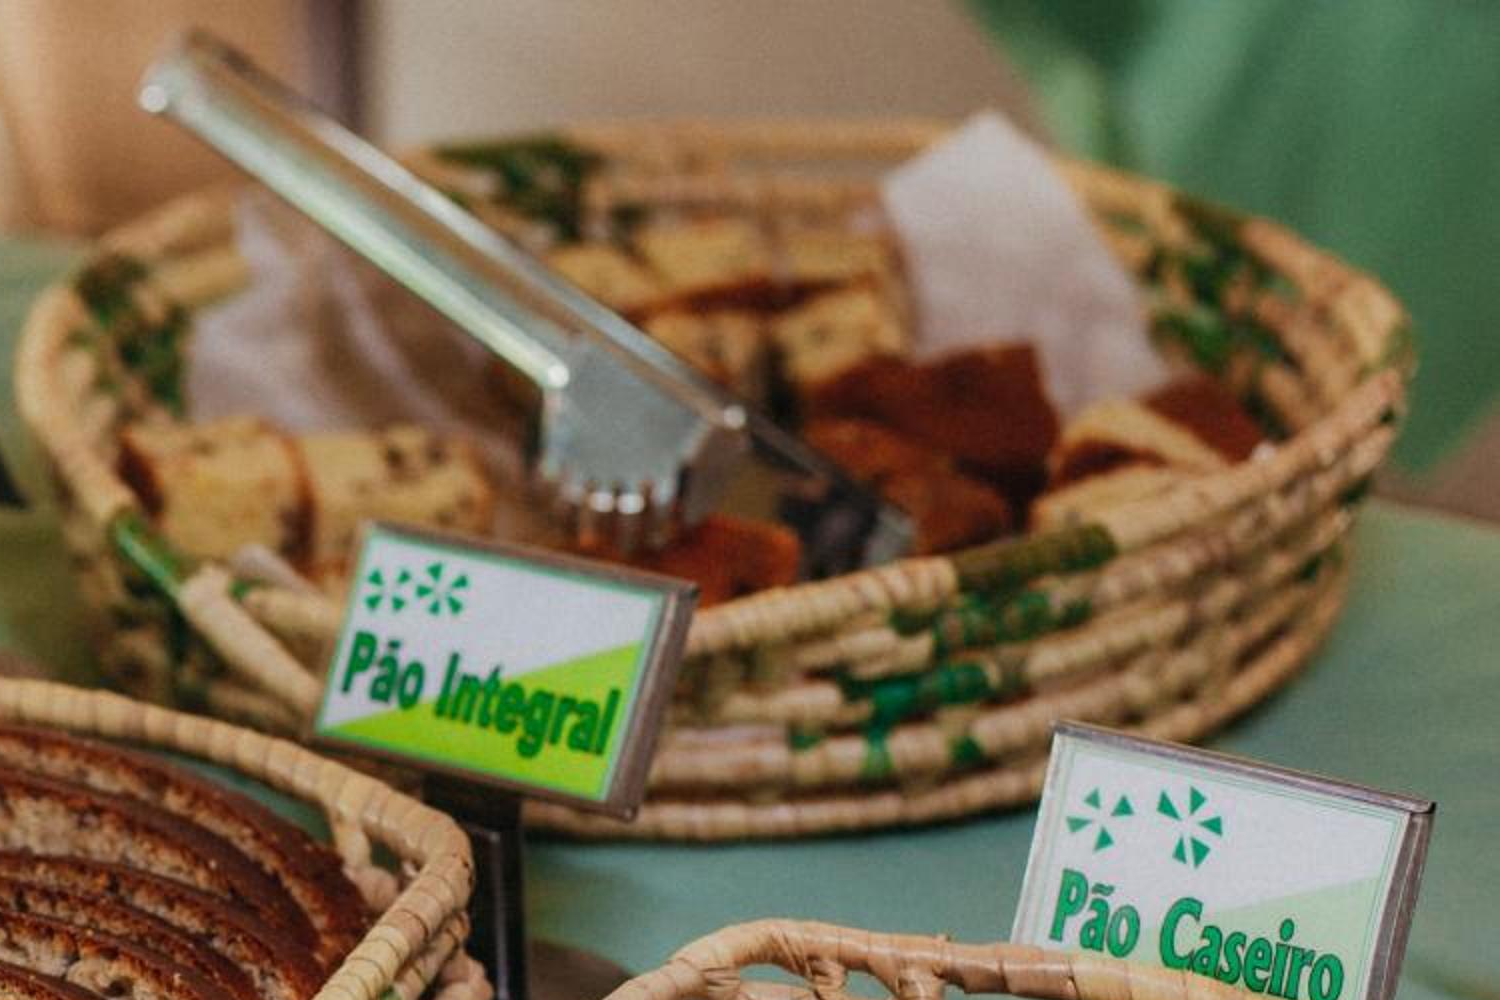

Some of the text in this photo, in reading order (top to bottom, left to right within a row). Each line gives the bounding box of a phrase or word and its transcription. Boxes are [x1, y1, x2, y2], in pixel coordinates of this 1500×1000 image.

[341, 631, 621, 758] Pão Integral
[1050, 869, 1141, 958] Pão
